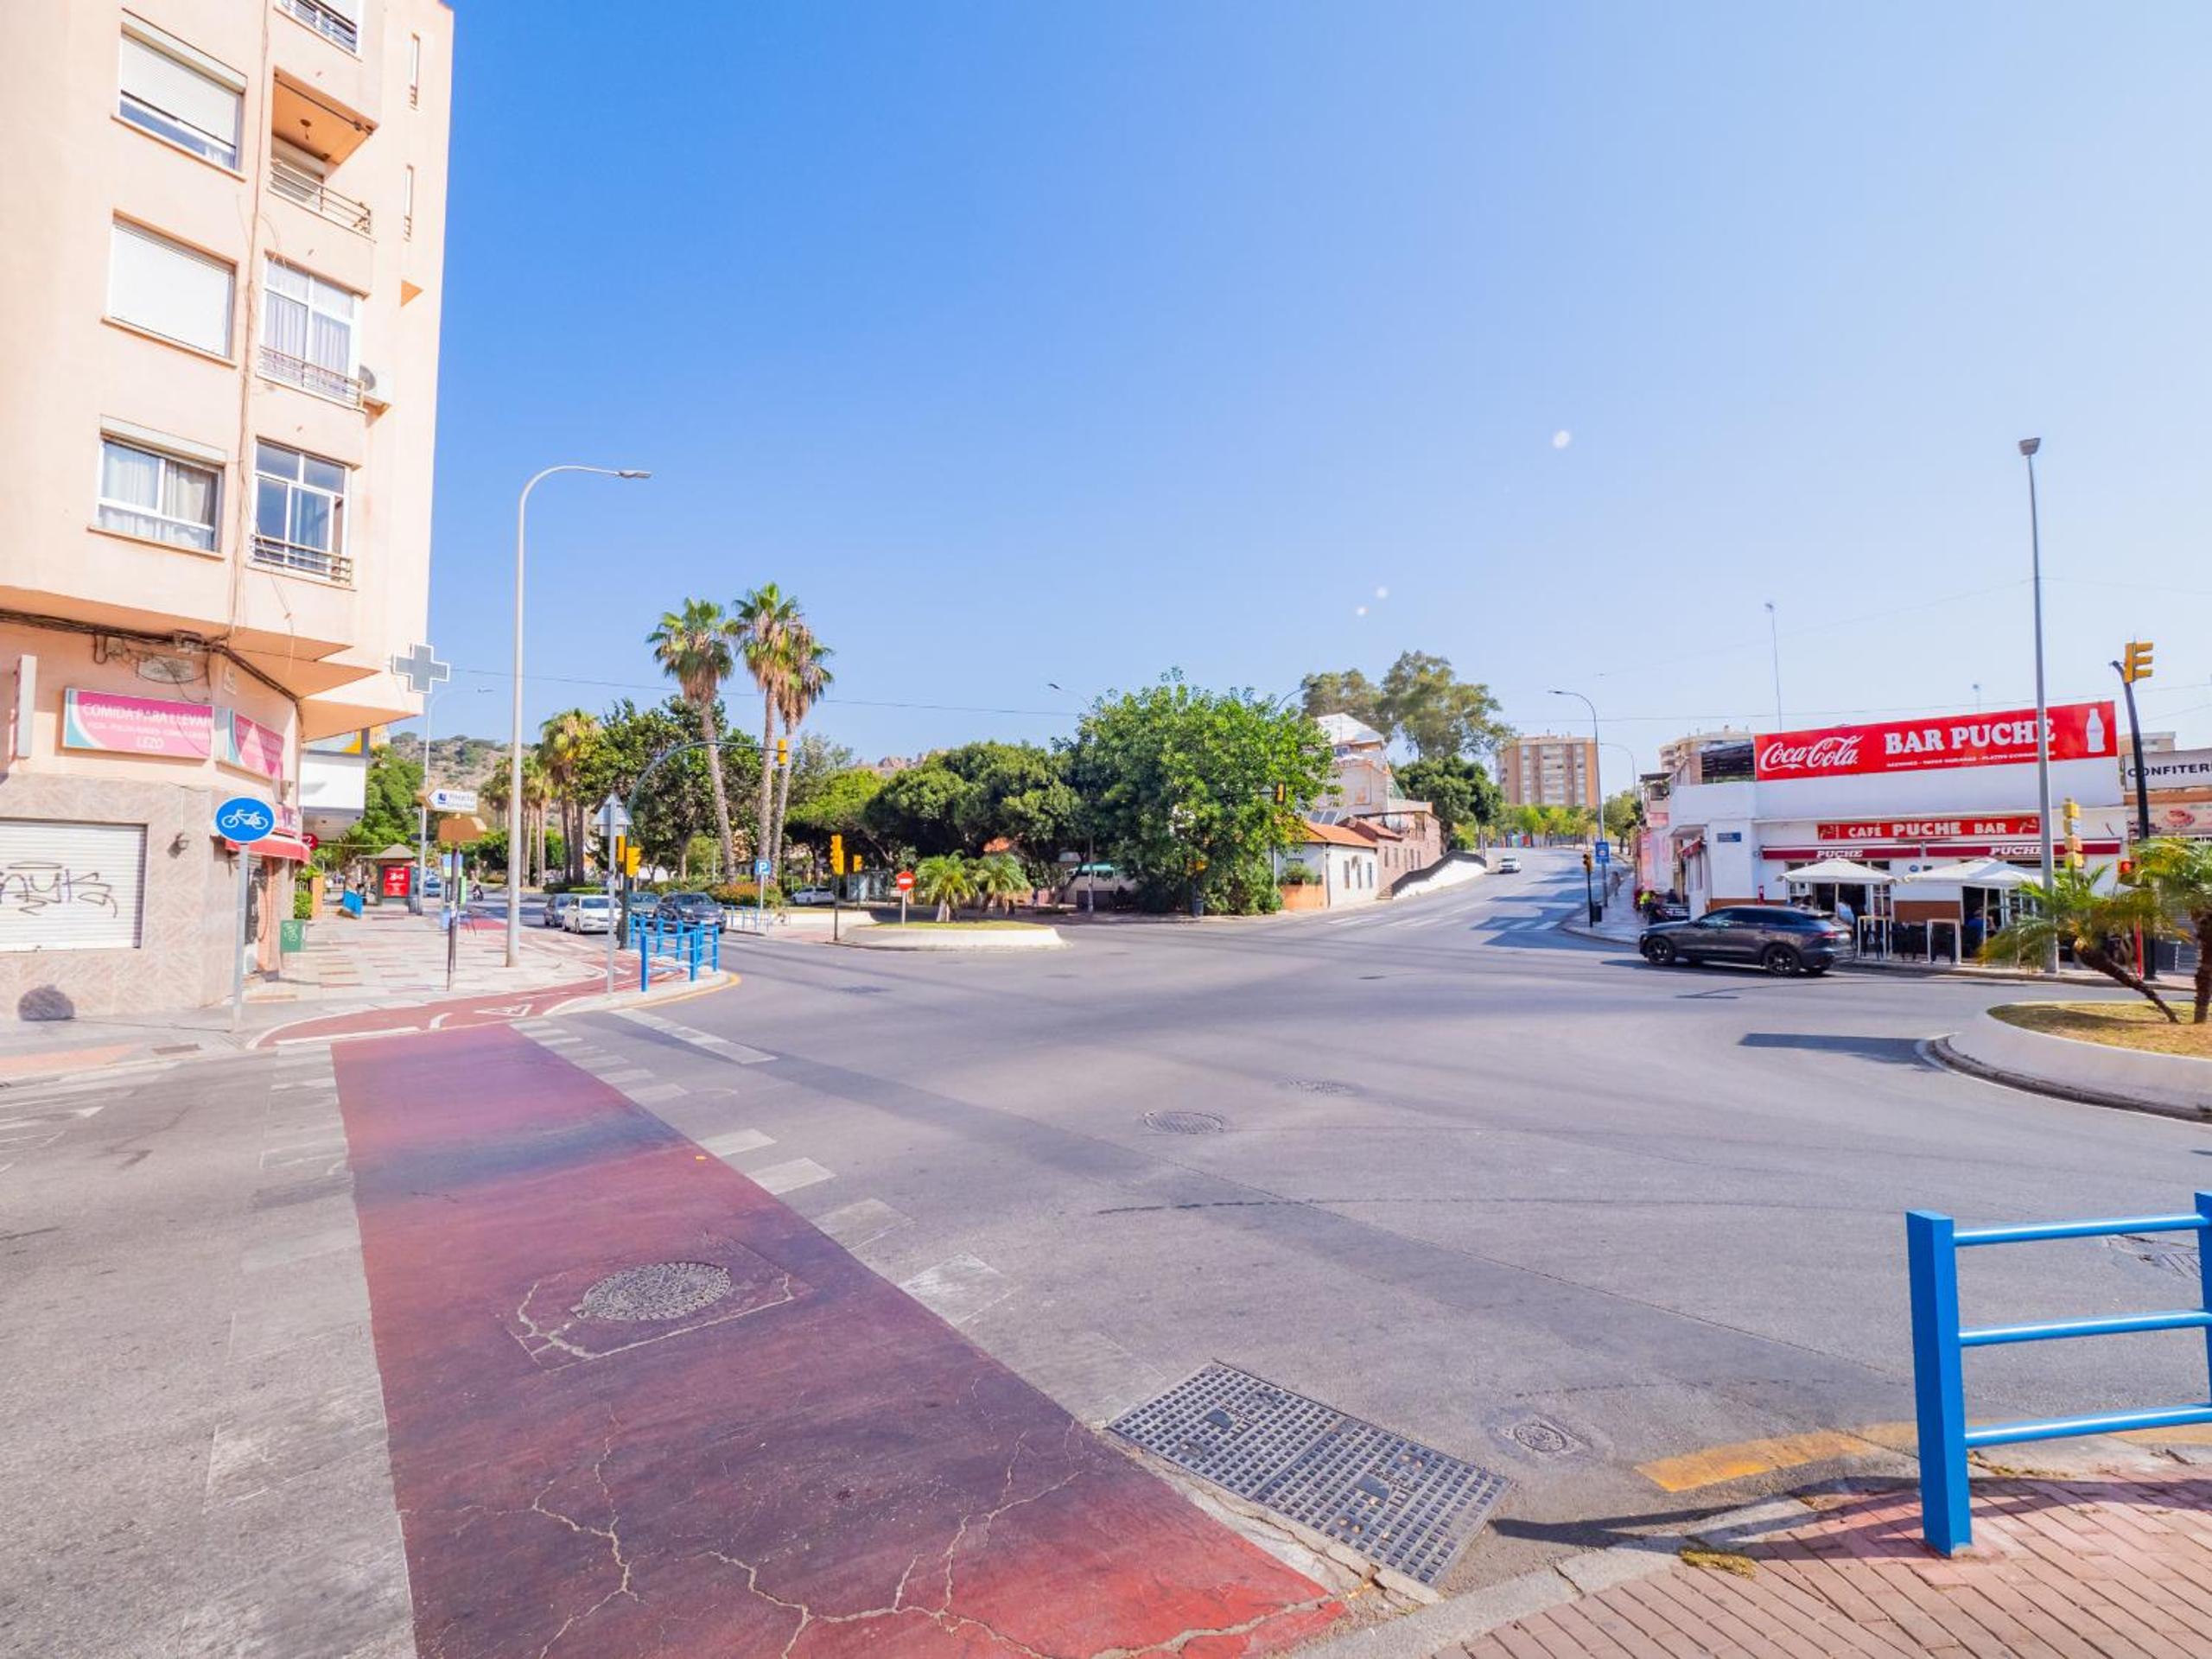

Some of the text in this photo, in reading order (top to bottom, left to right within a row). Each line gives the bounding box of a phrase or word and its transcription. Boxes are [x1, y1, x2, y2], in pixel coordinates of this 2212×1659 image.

[1885, 718, 2056, 755] BAR PUCHE
[1759, 734, 1865, 772] Coca-Cola
[2127, 763, 2212, 778] CONFITER
[1847, 821, 2007, 838] CAFÉ PUCHE BAR
[1816, 849, 1864, 859] PUCHE
